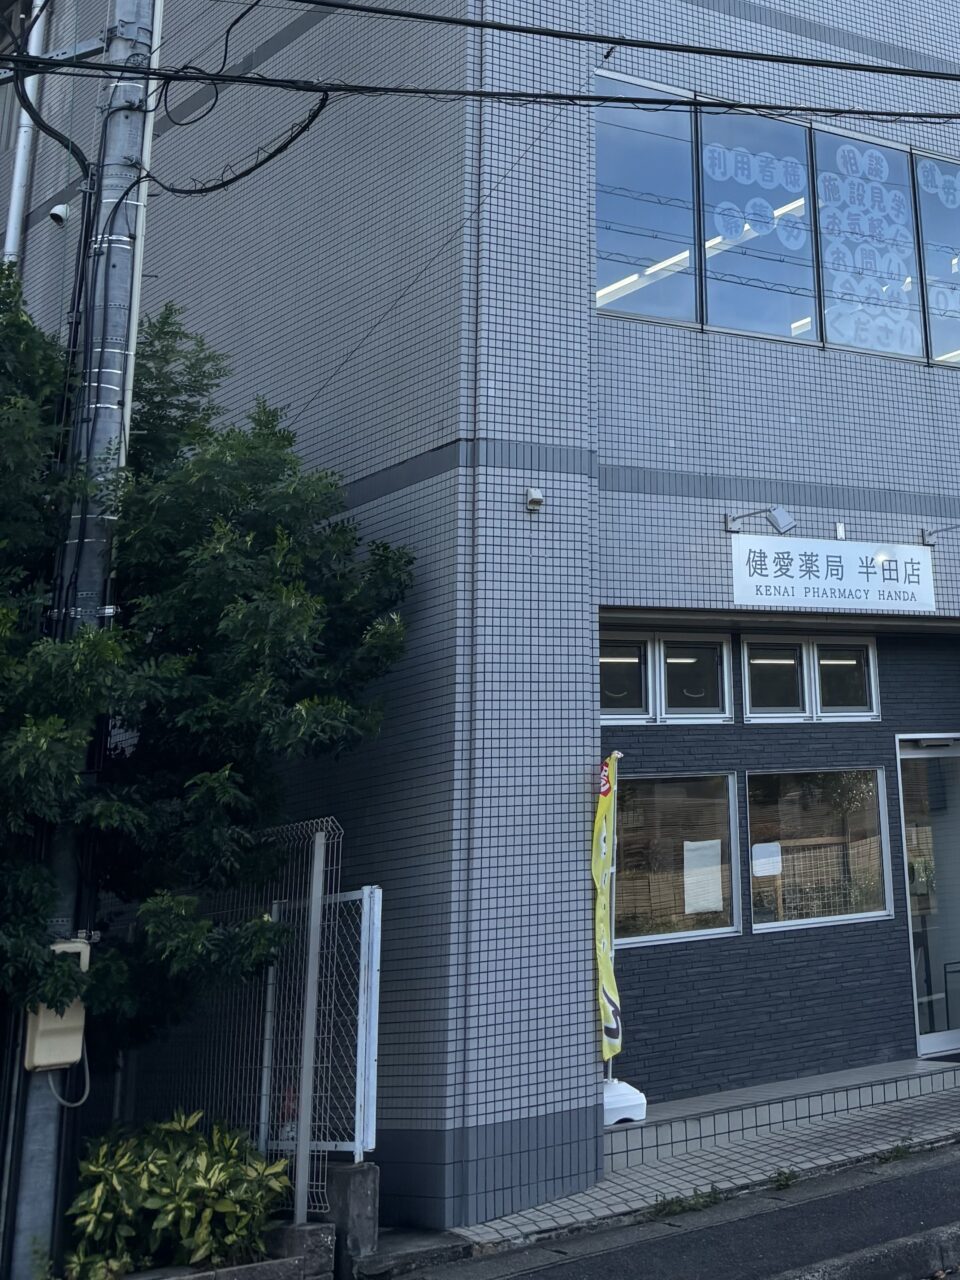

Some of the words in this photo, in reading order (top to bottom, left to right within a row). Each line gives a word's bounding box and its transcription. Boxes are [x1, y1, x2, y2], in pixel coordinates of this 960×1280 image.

[708, 148, 802, 188] 利用者様
[841, 150, 883, 180] 相談
[822, 175, 905, 217] 施設見学
[826, 208, 910, 254] お気軽に
[830, 311, 914, 350] ください
[745, 548, 844, 581] 健愛薬局
[858, 555, 921, 586] 半田店
[755, 584, 796, 597] KENAI
[804, 586, 870, 601] PHARMACY
[878, 590, 917, 602] HANDA
